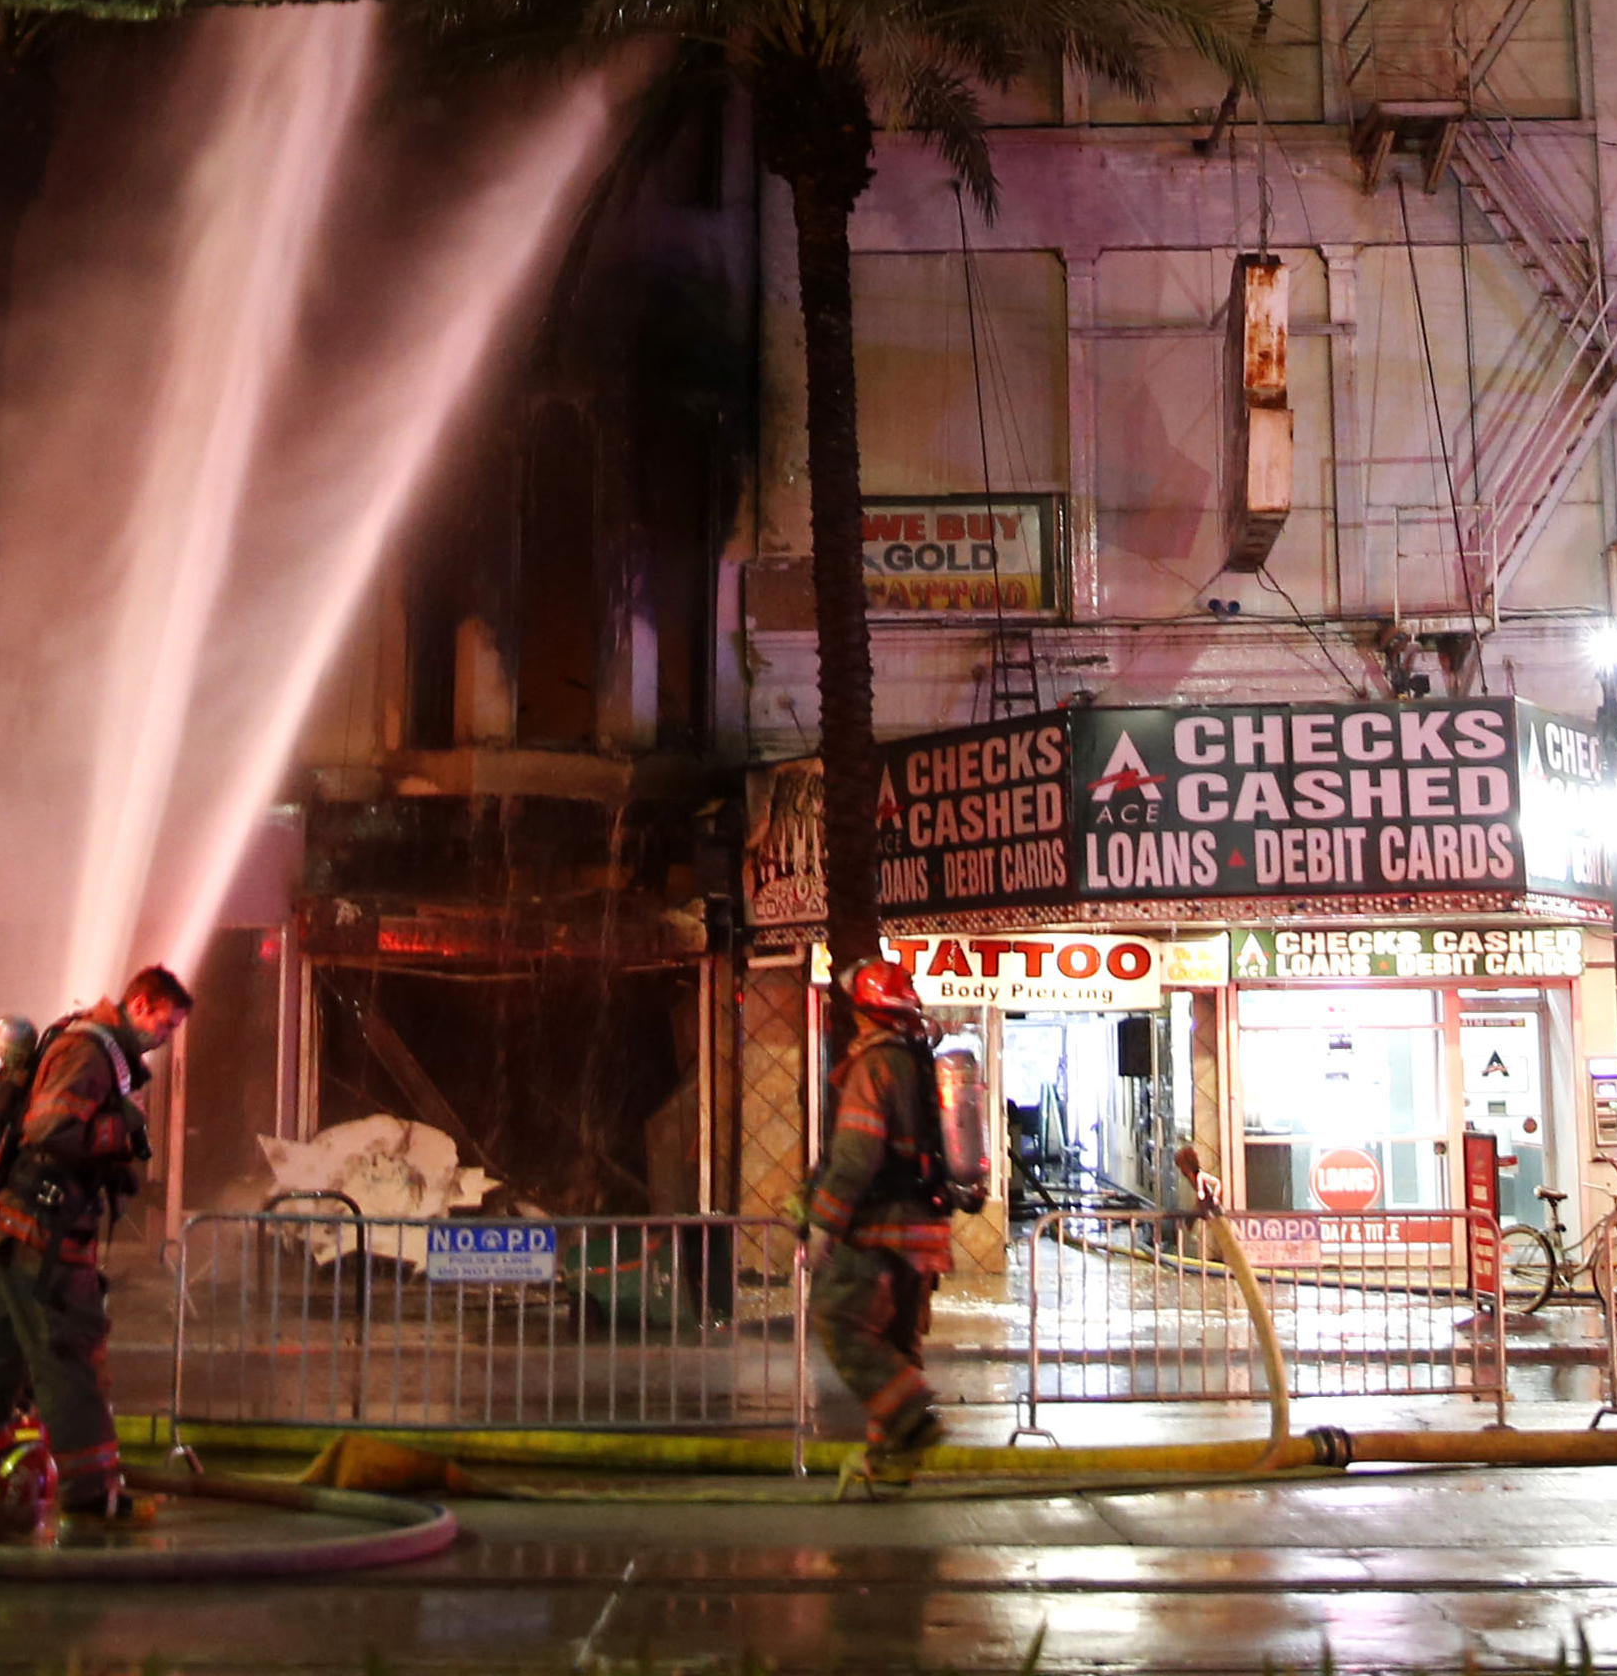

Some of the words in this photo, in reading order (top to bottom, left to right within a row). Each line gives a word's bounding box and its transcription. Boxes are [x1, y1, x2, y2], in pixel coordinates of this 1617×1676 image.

[937, 514, 1022, 541] BUY
[884, 544, 998, 572] GOLD
[1173, 709, 1506, 766] CHECKS
[906, 726, 1062, 797] CHECKS
[1176, 766, 1512, 822] CASHED
[908, 782, 1062, 848] CASHED
[1096, 802, 1159, 825] ACE
[943, 848, 996, 899] DEBIT
[1000, 838, 1066, 894] CARDS
[1086, 829, 1218, 890] LOANS
[1254, 826, 1367, 885] DEBIT
[1380, 823, 1515, 883] CARDS
[1274, 930, 1422, 954] CHECKS
[1432, 929, 1583, 954] CASHED
[889, 938, 1152, 980] TATTOO
[1275, 953, 1371, 976] LOANS
[1396, 953, 1475, 976] DEBIT
[1484, 952, 1584, 976] CARDS
[940, 982, 999, 1002] Body
[1011, 982, 1114, 1004] Piercing
[1317, 1167, 1376, 1193] LOANS
[1350, 1223, 1362, 1242] &
